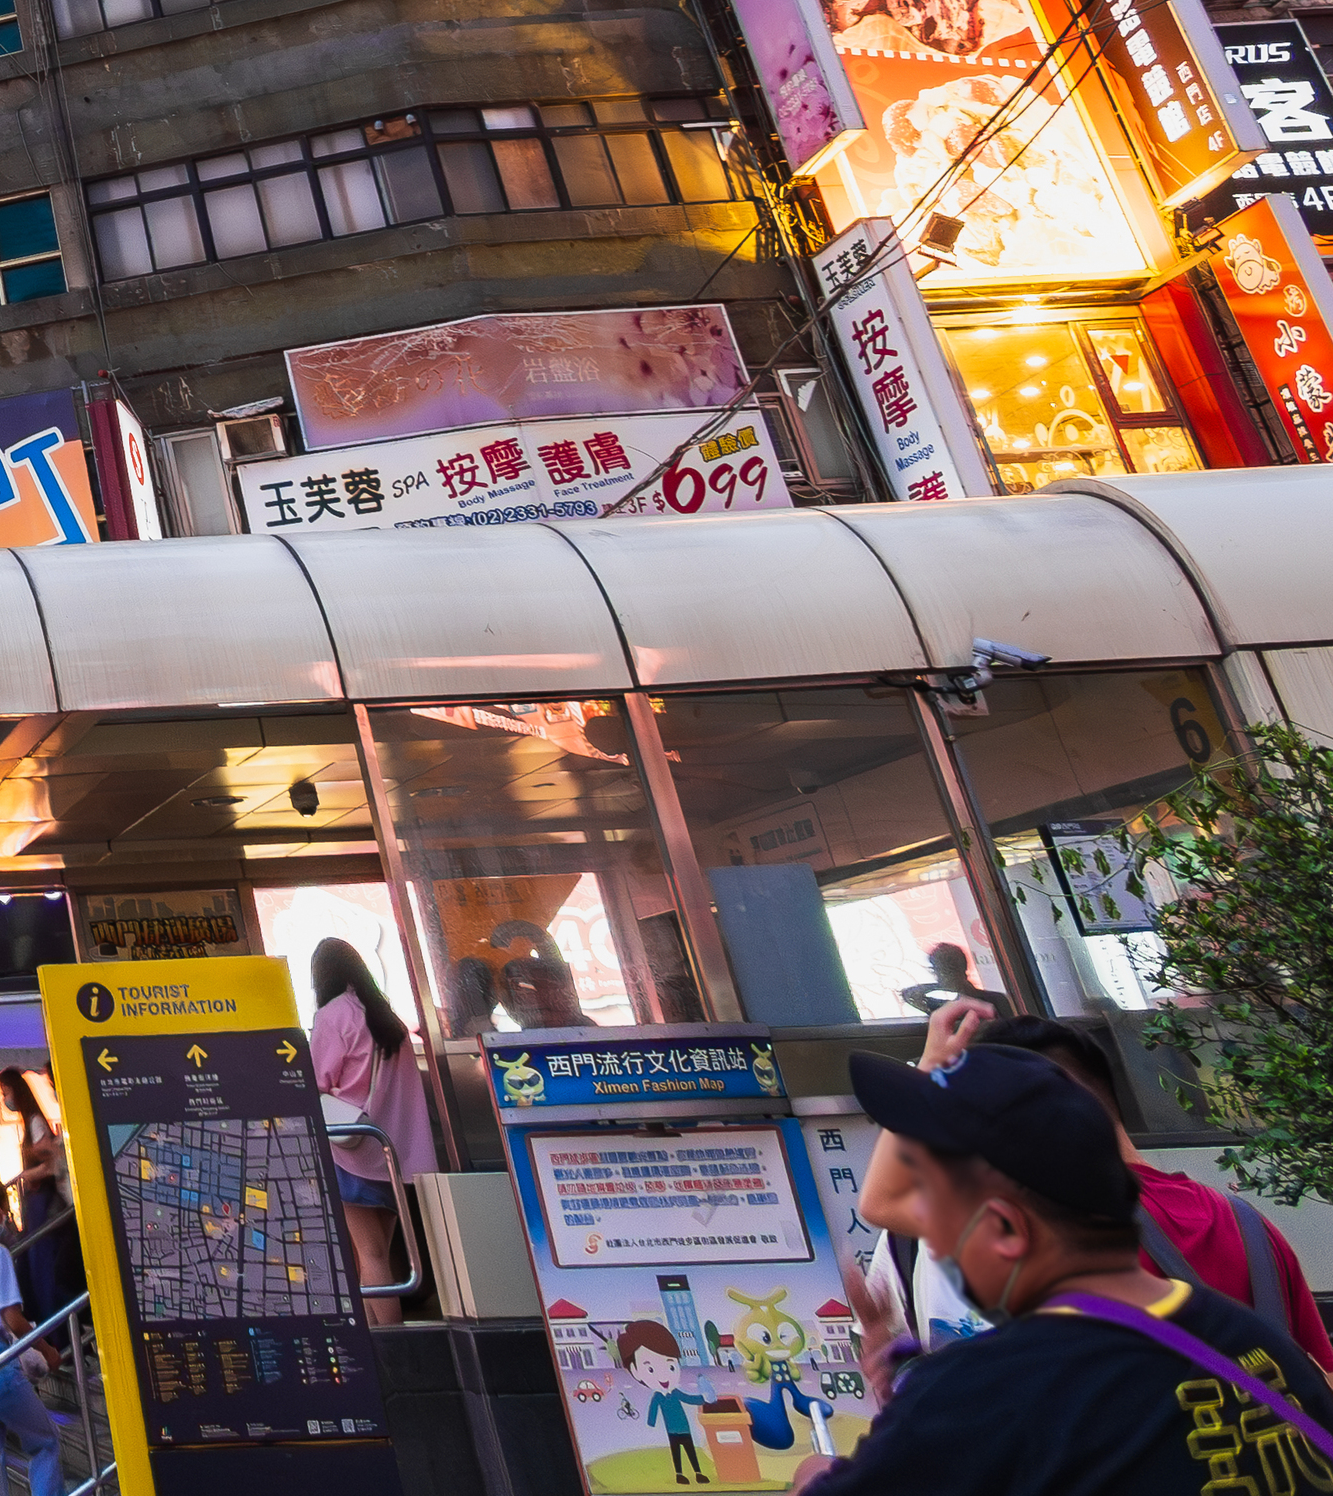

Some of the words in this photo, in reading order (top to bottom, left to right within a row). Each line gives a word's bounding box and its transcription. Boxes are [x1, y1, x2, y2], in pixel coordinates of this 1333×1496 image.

[1224, 40, 1292, 65] RUS
[1175, 59, 1214, 126] 西門店
[1239, 77, 1333, 143] 客
[1208, 125, 1225, 154] 4F
[851, 308, 919, 435] 按摩
[698, 425, 762, 463] 體驗價
[896, 430, 921, 452] Body
[434, 435, 537, 501] 按摩
[536, 431, 633, 485] 護膚
[895, 442, 935, 472] Massage
[259, 466, 387, 529] 玉芙蓉
[391, 470, 431, 500] SPA
[458, 490, 486, 509] Body
[487, 477, 537, 500] Massage
[553, 486, 580, 498] Face
[580, 472, 636, 493] Treatment
[118, 982, 191, 1002] TOURIST
[120, 997, 238, 1017] INFORMATION
[544, 1047, 749, 1079] 西門流行文化資訊站
[592, 1079, 640, 1096] Ximen
[641, 1077, 697, 1094] Fashion
[698, 1076, 726, 1094] Map
